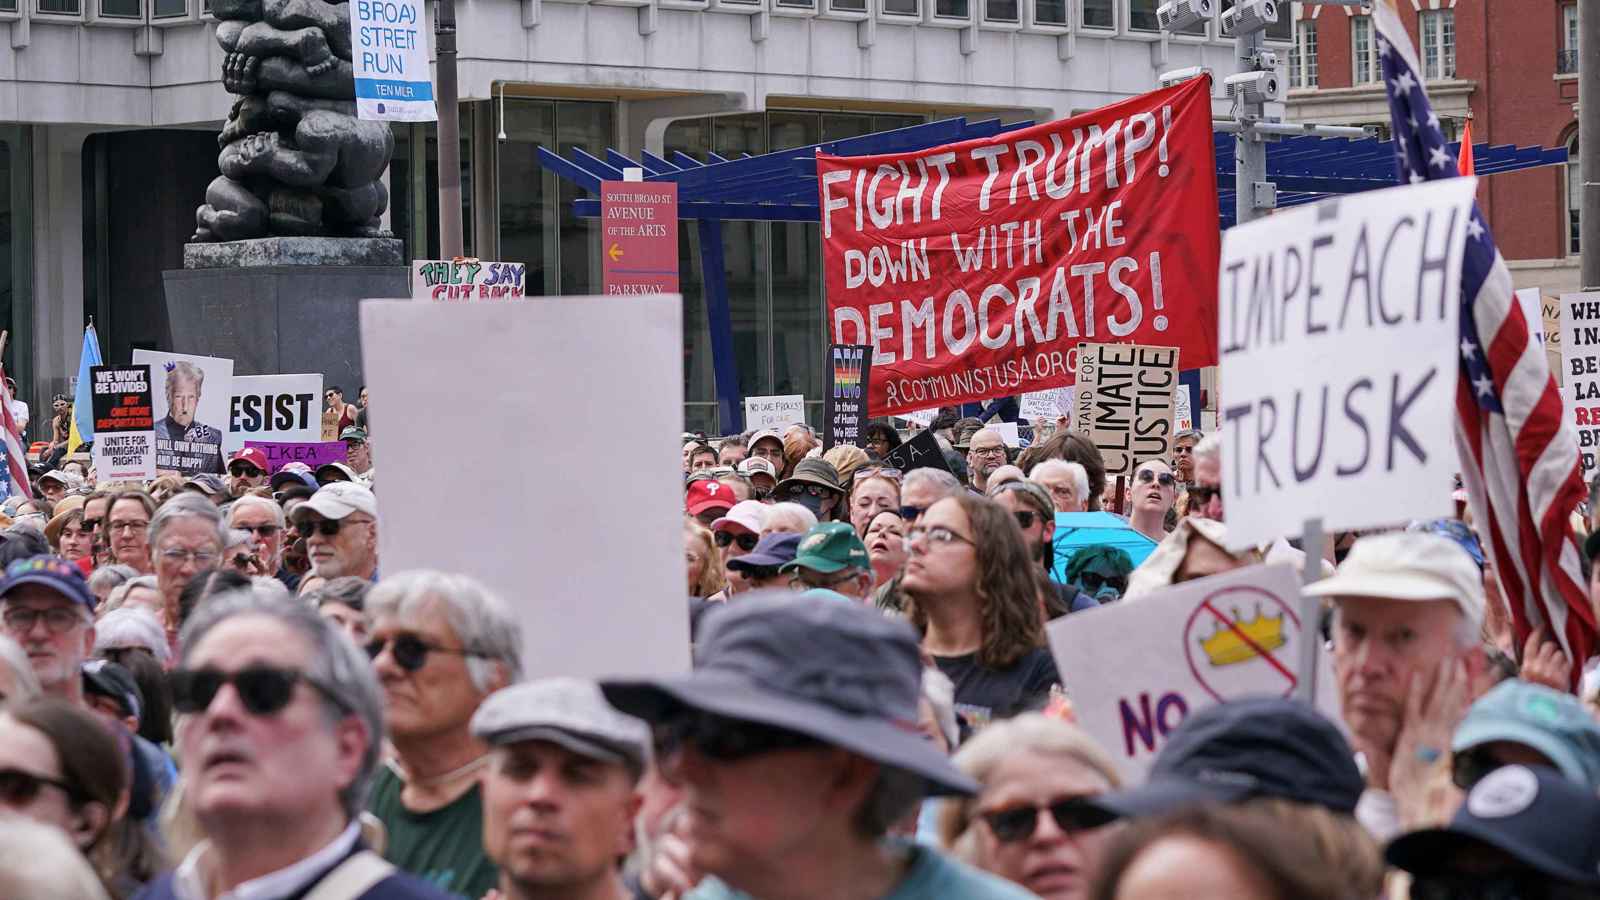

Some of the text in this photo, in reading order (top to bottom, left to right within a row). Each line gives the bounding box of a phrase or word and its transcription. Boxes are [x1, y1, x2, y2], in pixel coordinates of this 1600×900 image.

[363, 52, 403, 74] RUN
[376, 84, 393, 97] TEN
[822, 104, 1173, 239] FIGHT TRUMP!
[607, 193, 633, 203] SOUTH
[634, 193, 661, 204] BROAD
[607, 207, 655, 220] AVENUE
[607, 224, 666, 237] OF THE ARTS
[845, 200, 1126, 289] DOWN WITH THE
[419, 261, 526, 287] THEY SAY
[1223, 206, 1458, 356] IMPEACH
[432, 285, 475, 300] CUT
[609, 284, 665, 296] PARKWAY
[833, 251, 1170, 366] DEMOCRATS!
[1574, 327, 1600, 345] IN
[1081, 356, 1094, 383] FOR
[1571, 356, 1600, 375] BE
[95, 370, 145, 382] WE WON'T
[95, 381, 148, 394] BE DIVIDED
[229, 393, 314, 433] ESIST
[1095, 346, 1136, 474] CLIMATE
[833, 427, 844, 438] We
[1224, 366, 1438, 497] TRUSK
[104, 435, 147, 446] UNITE FOR
[157, 439, 218, 455] WILL OWN NOTHING
[102, 445, 149, 457] IMMIGRANT
[264, 445, 318, 460] IKEA
[112, 456, 143, 467] RIGHTS
[157, 455, 203, 469] AND BE HAPPY
[1118, 690, 1189, 757] NO
